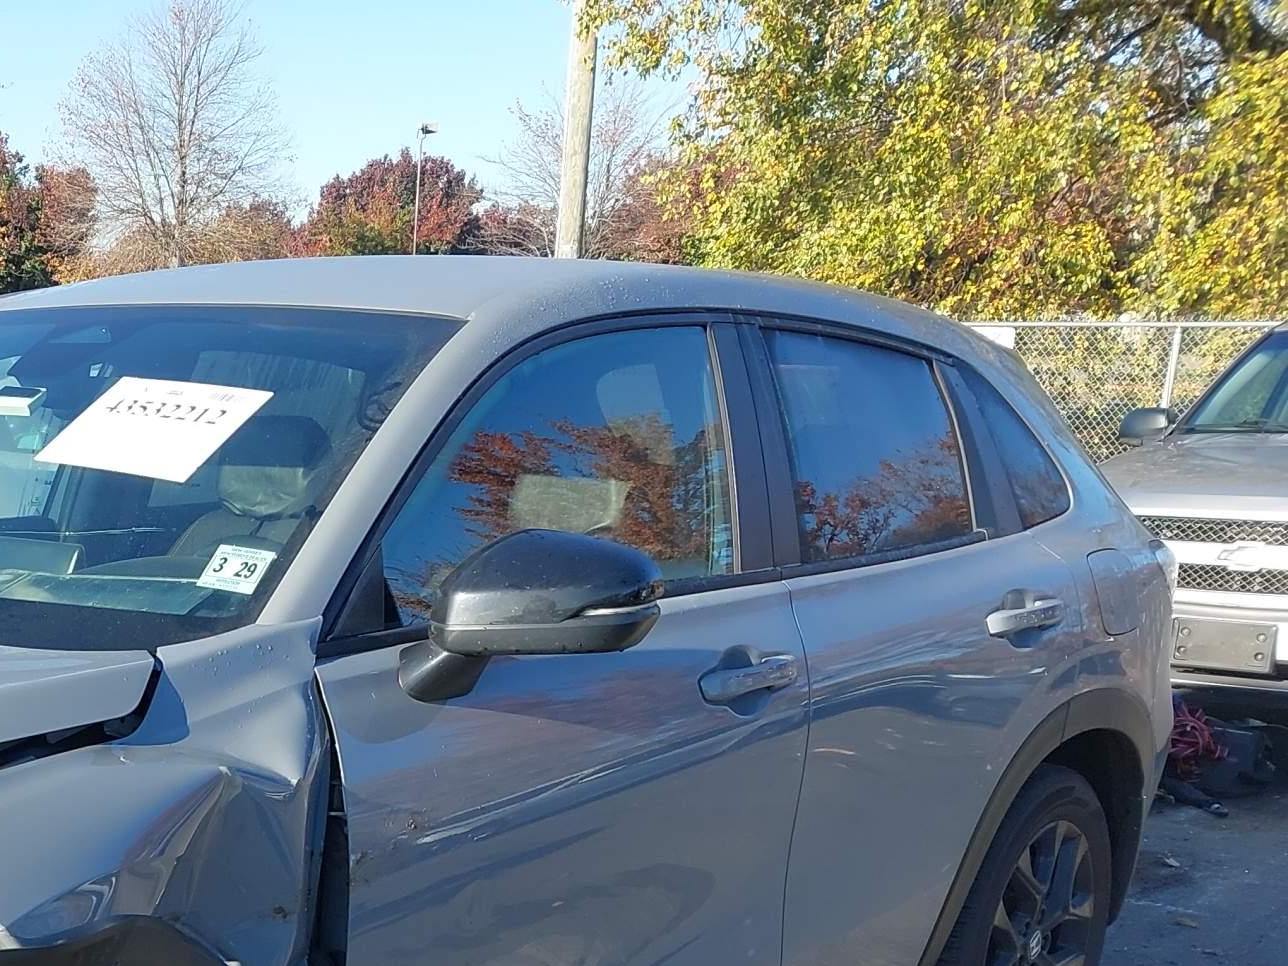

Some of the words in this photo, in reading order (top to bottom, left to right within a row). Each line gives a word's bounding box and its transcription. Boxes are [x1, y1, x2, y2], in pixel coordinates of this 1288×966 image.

[106, 399, 228, 425] 43532212
[213, 556, 228, 573] 3
[234, 561, 258, 579] 29
